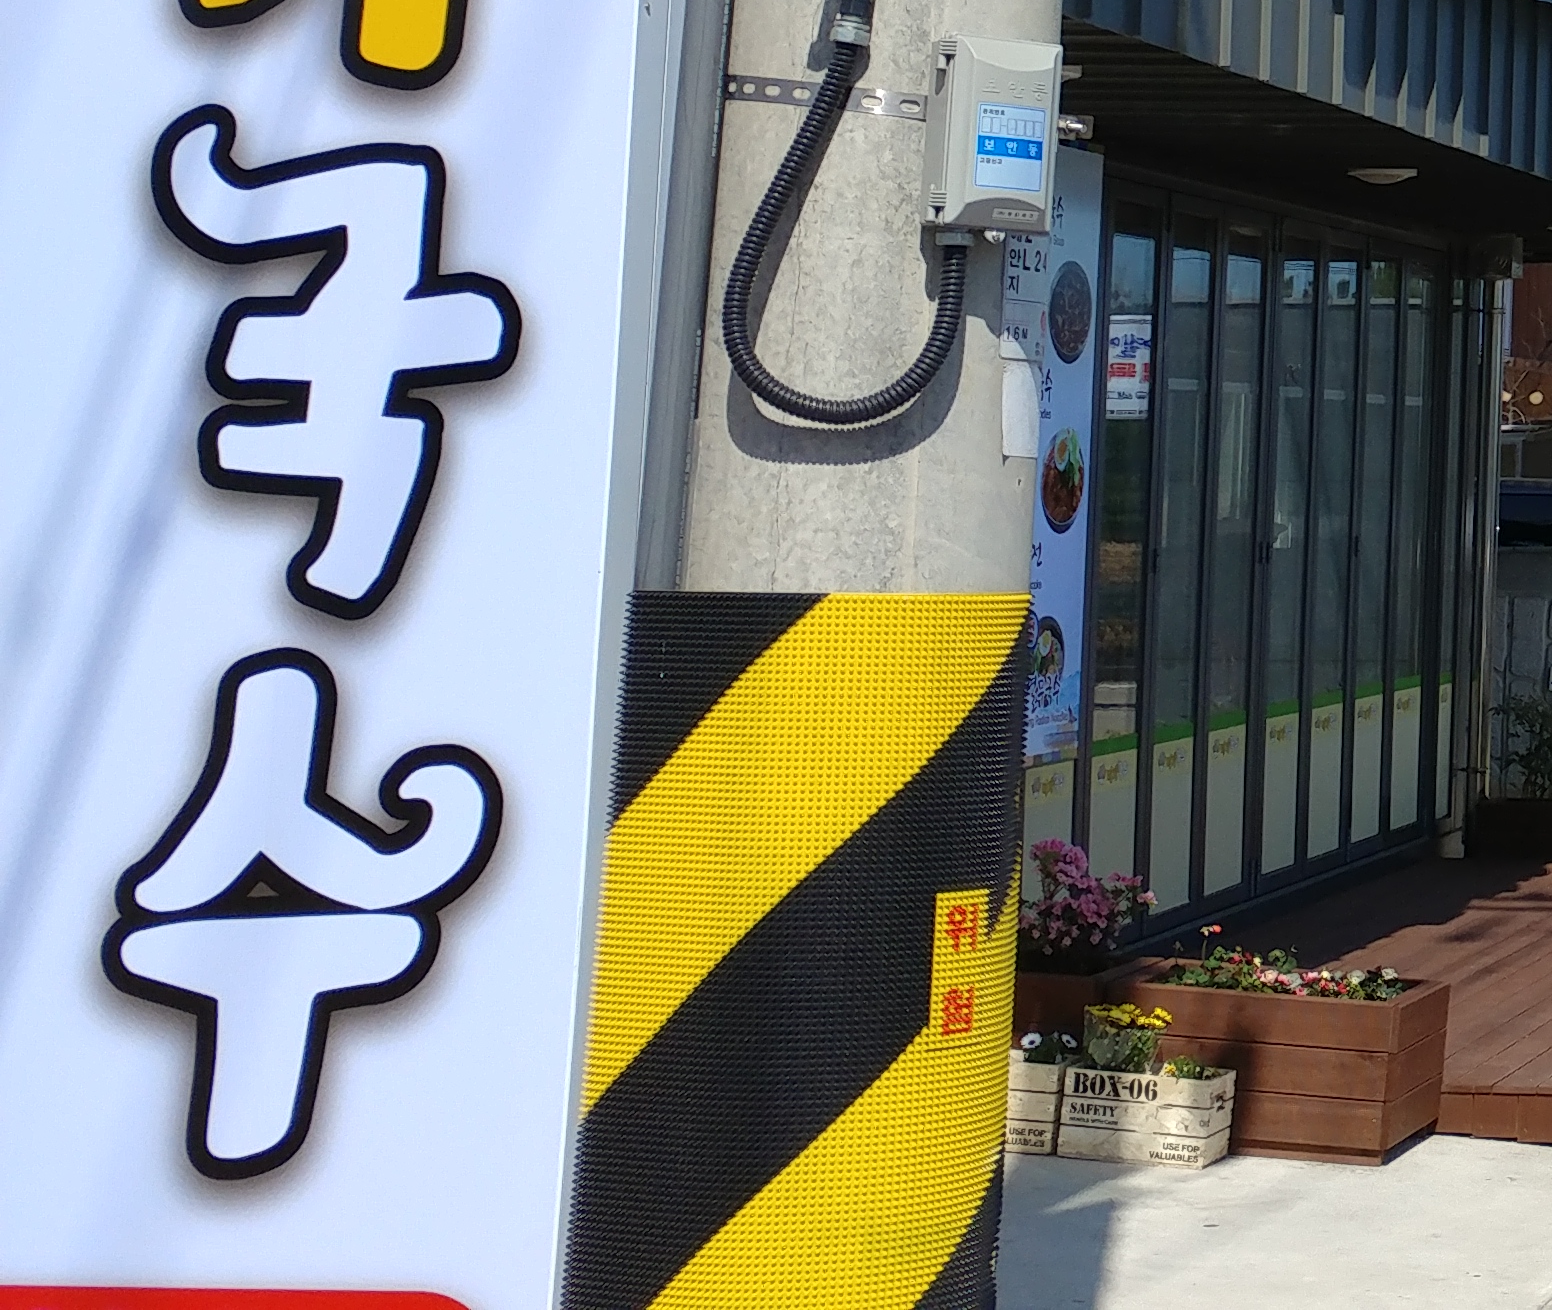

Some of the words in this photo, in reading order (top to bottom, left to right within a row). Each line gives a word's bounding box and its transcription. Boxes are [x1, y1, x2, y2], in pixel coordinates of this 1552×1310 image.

[983, 138, 1039, 157] 보안등
[942, 903, 979, 1037] 위험
[1072, 1072, 1158, 1102] BOX-06
[1070, 1101, 1118, 1118] SAFETY
[1009, 1127, 1026, 1136] USE
[1006, 1137, 1046, 1148] LUABLES
[1162, 1142, 1180, 1151] USE
[1181, 1144, 1201, 1153] FOR
[1149, 1150, 1199, 1163] VALUABLES
